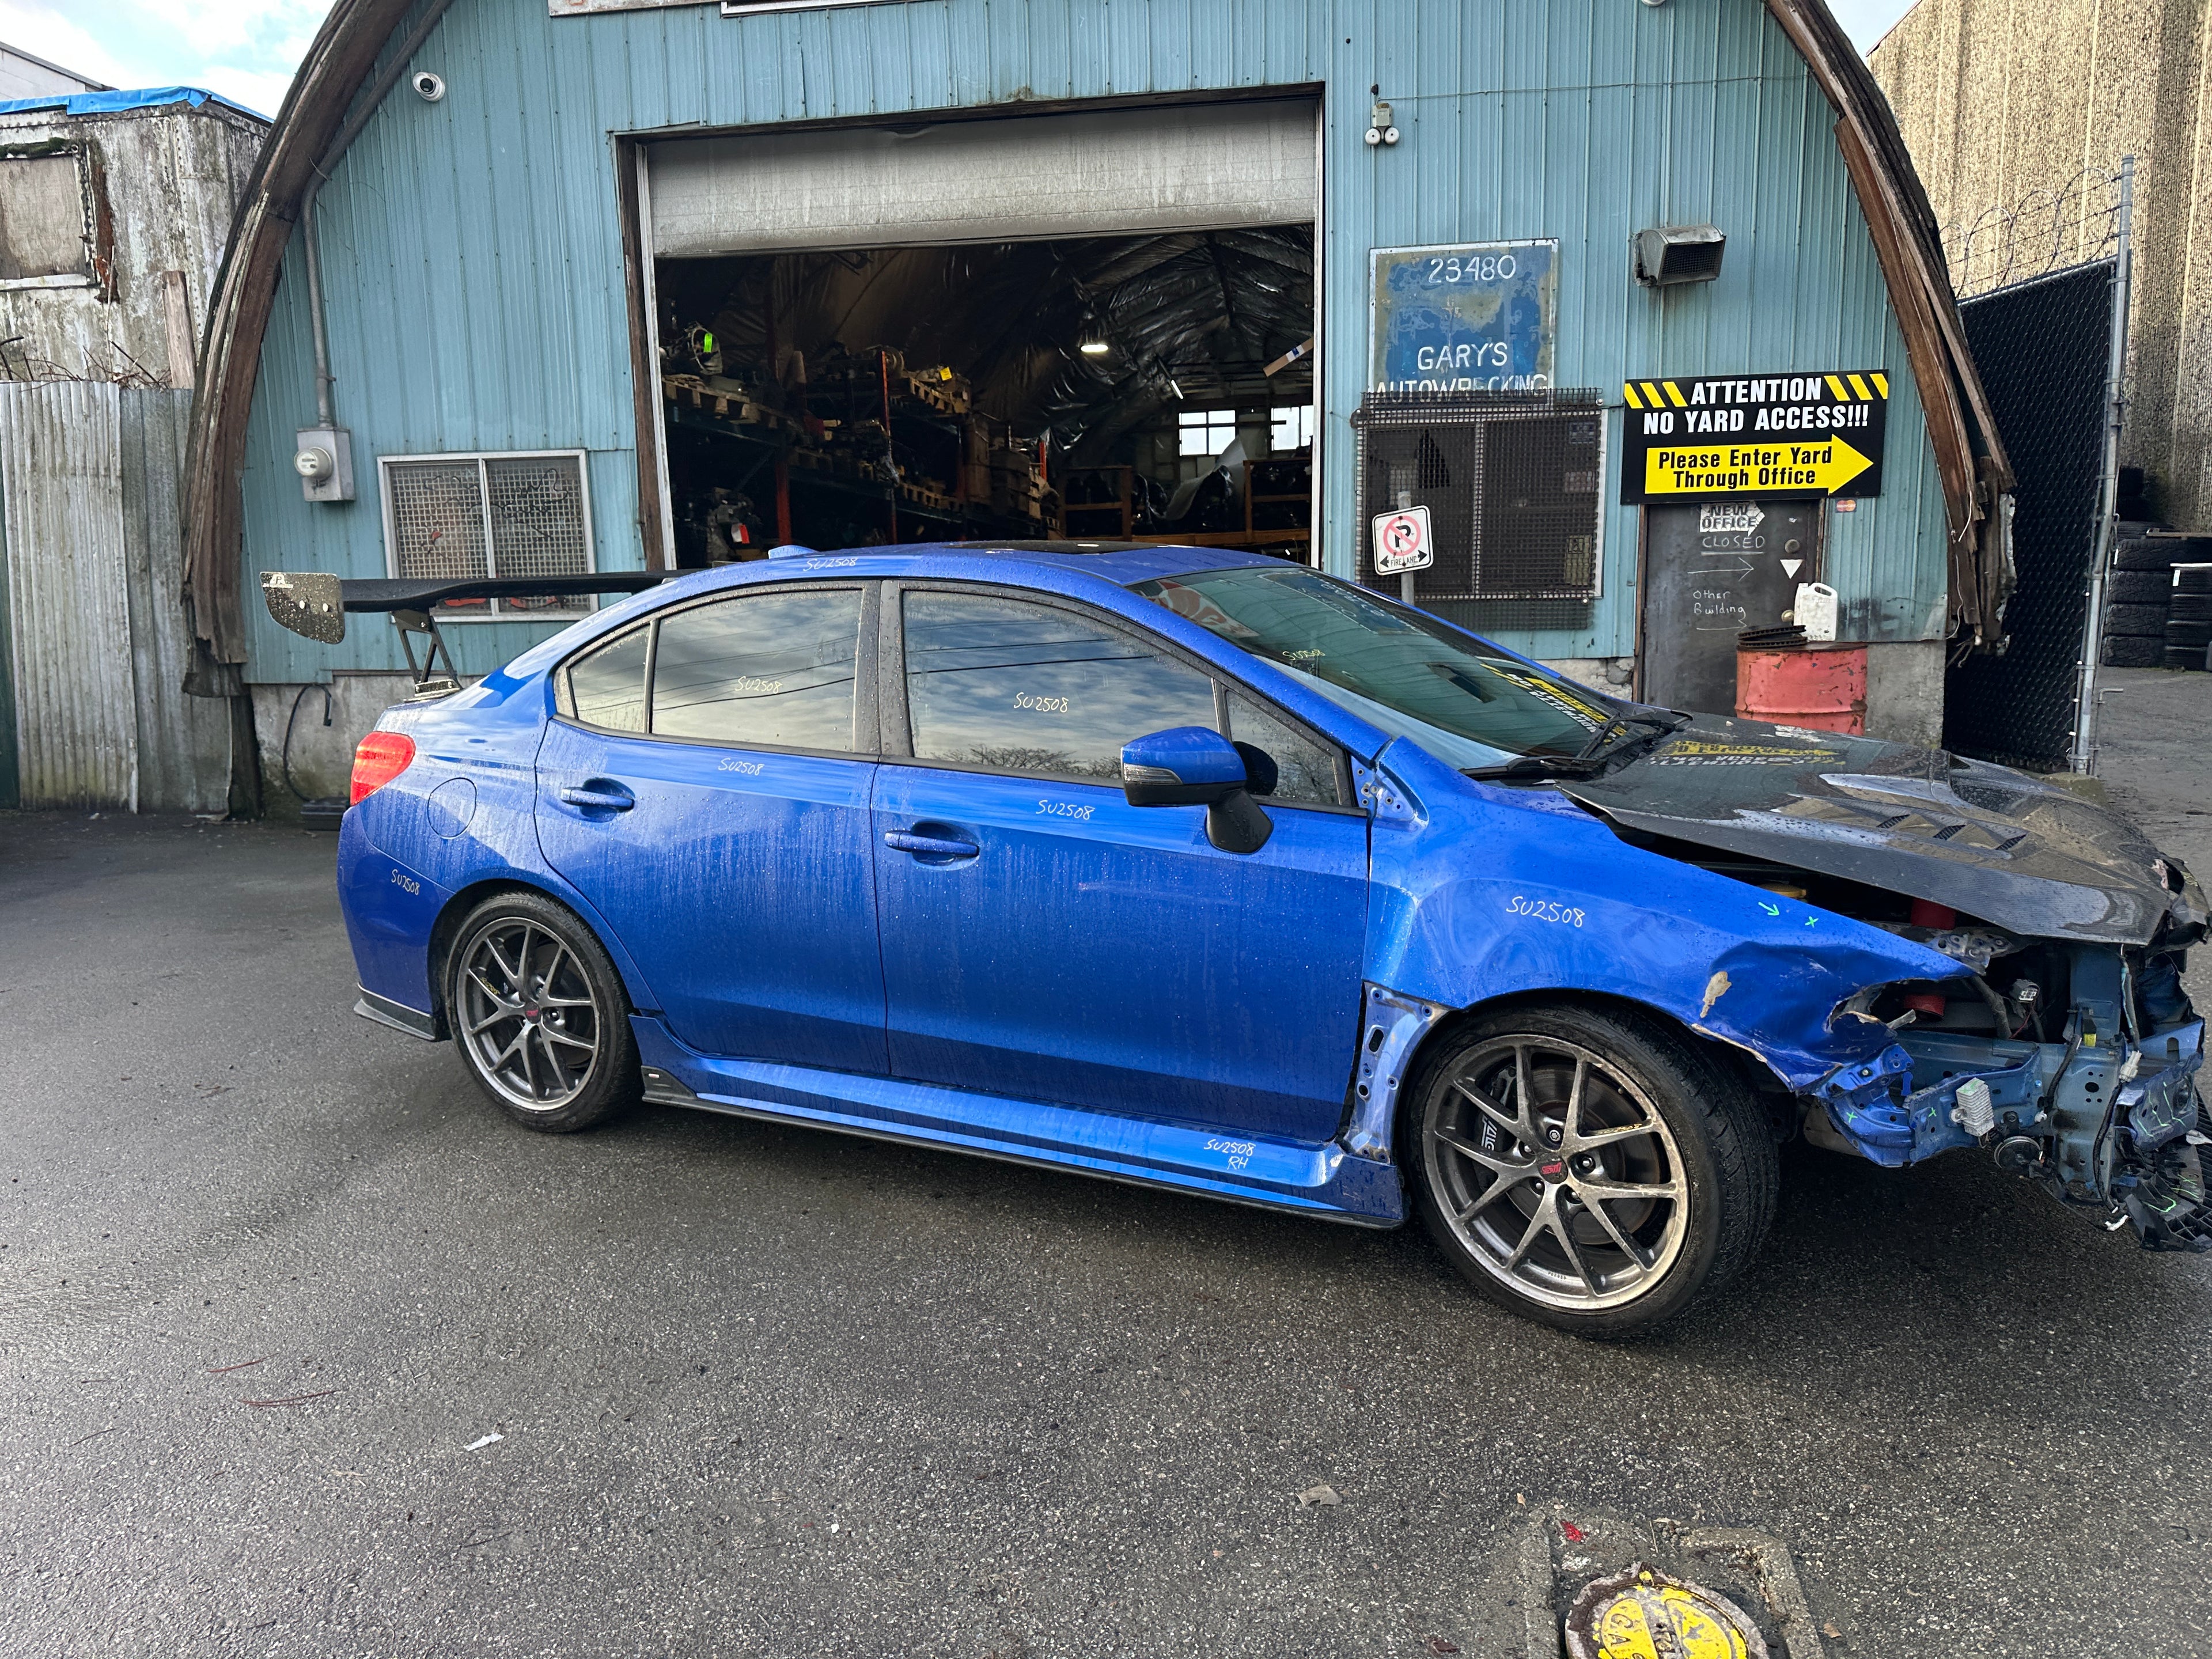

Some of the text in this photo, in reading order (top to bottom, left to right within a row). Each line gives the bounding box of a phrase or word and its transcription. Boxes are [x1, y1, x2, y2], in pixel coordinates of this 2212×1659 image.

[1428, 255, 1516, 283] 23480
[1418, 342, 1508, 370] GARY'S
[1690, 377, 1821, 405] ATTENTION
[1643, 404, 1869, 434] NO YARD ACCESS!!!
[1659, 446, 1832, 469] Please Enter Yard
[1673, 468, 1816, 489] Through Office
[1710, 503, 1748, 516] NEW
[1702, 516, 1756, 529] OFFICE
[1702, 535, 1765, 548] CLOSED
[803, 557, 858, 571] SU2508
[1391, 559, 1402, 567] FIRE
[1694, 602, 1746, 620] Building
[734, 676, 783, 694] SU2508
[1014, 692, 1069, 713] SU2508
[718, 757, 764, 776] SU2508
[1036, 800, 1095, 820] SU2508
[391, 869, 420, 895] SU2508
[1506, 896, 1585, 928] SU2508
[1203, 1139, 1256, 1156] SU2508
[1227, 1156, 1248, 1170] RH
